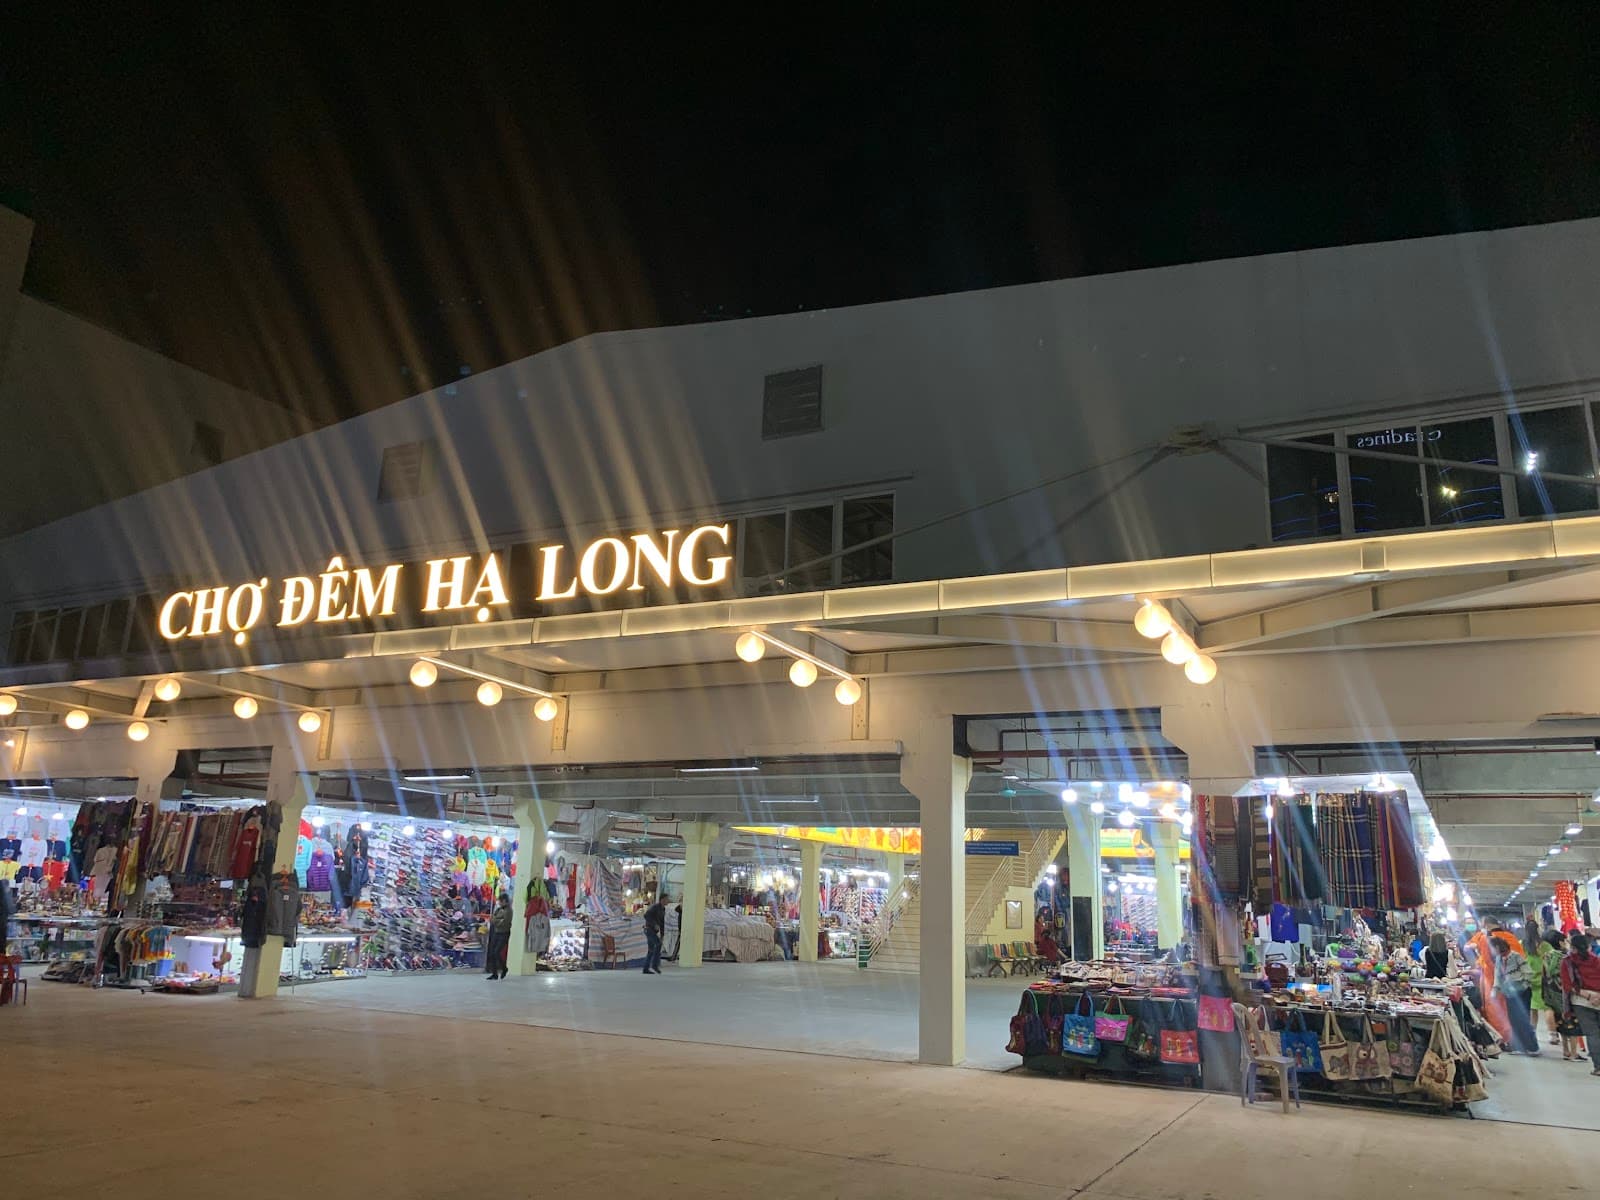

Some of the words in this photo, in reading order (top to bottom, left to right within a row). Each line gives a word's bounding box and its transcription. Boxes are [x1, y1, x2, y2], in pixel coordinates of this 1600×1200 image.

[158, 576, 269, 647] CHỢ
[276, 555, 405, 628] ĐÊM
[421, 551, 510, 623] HẠ
[537, 523, 733, 602] LONG
